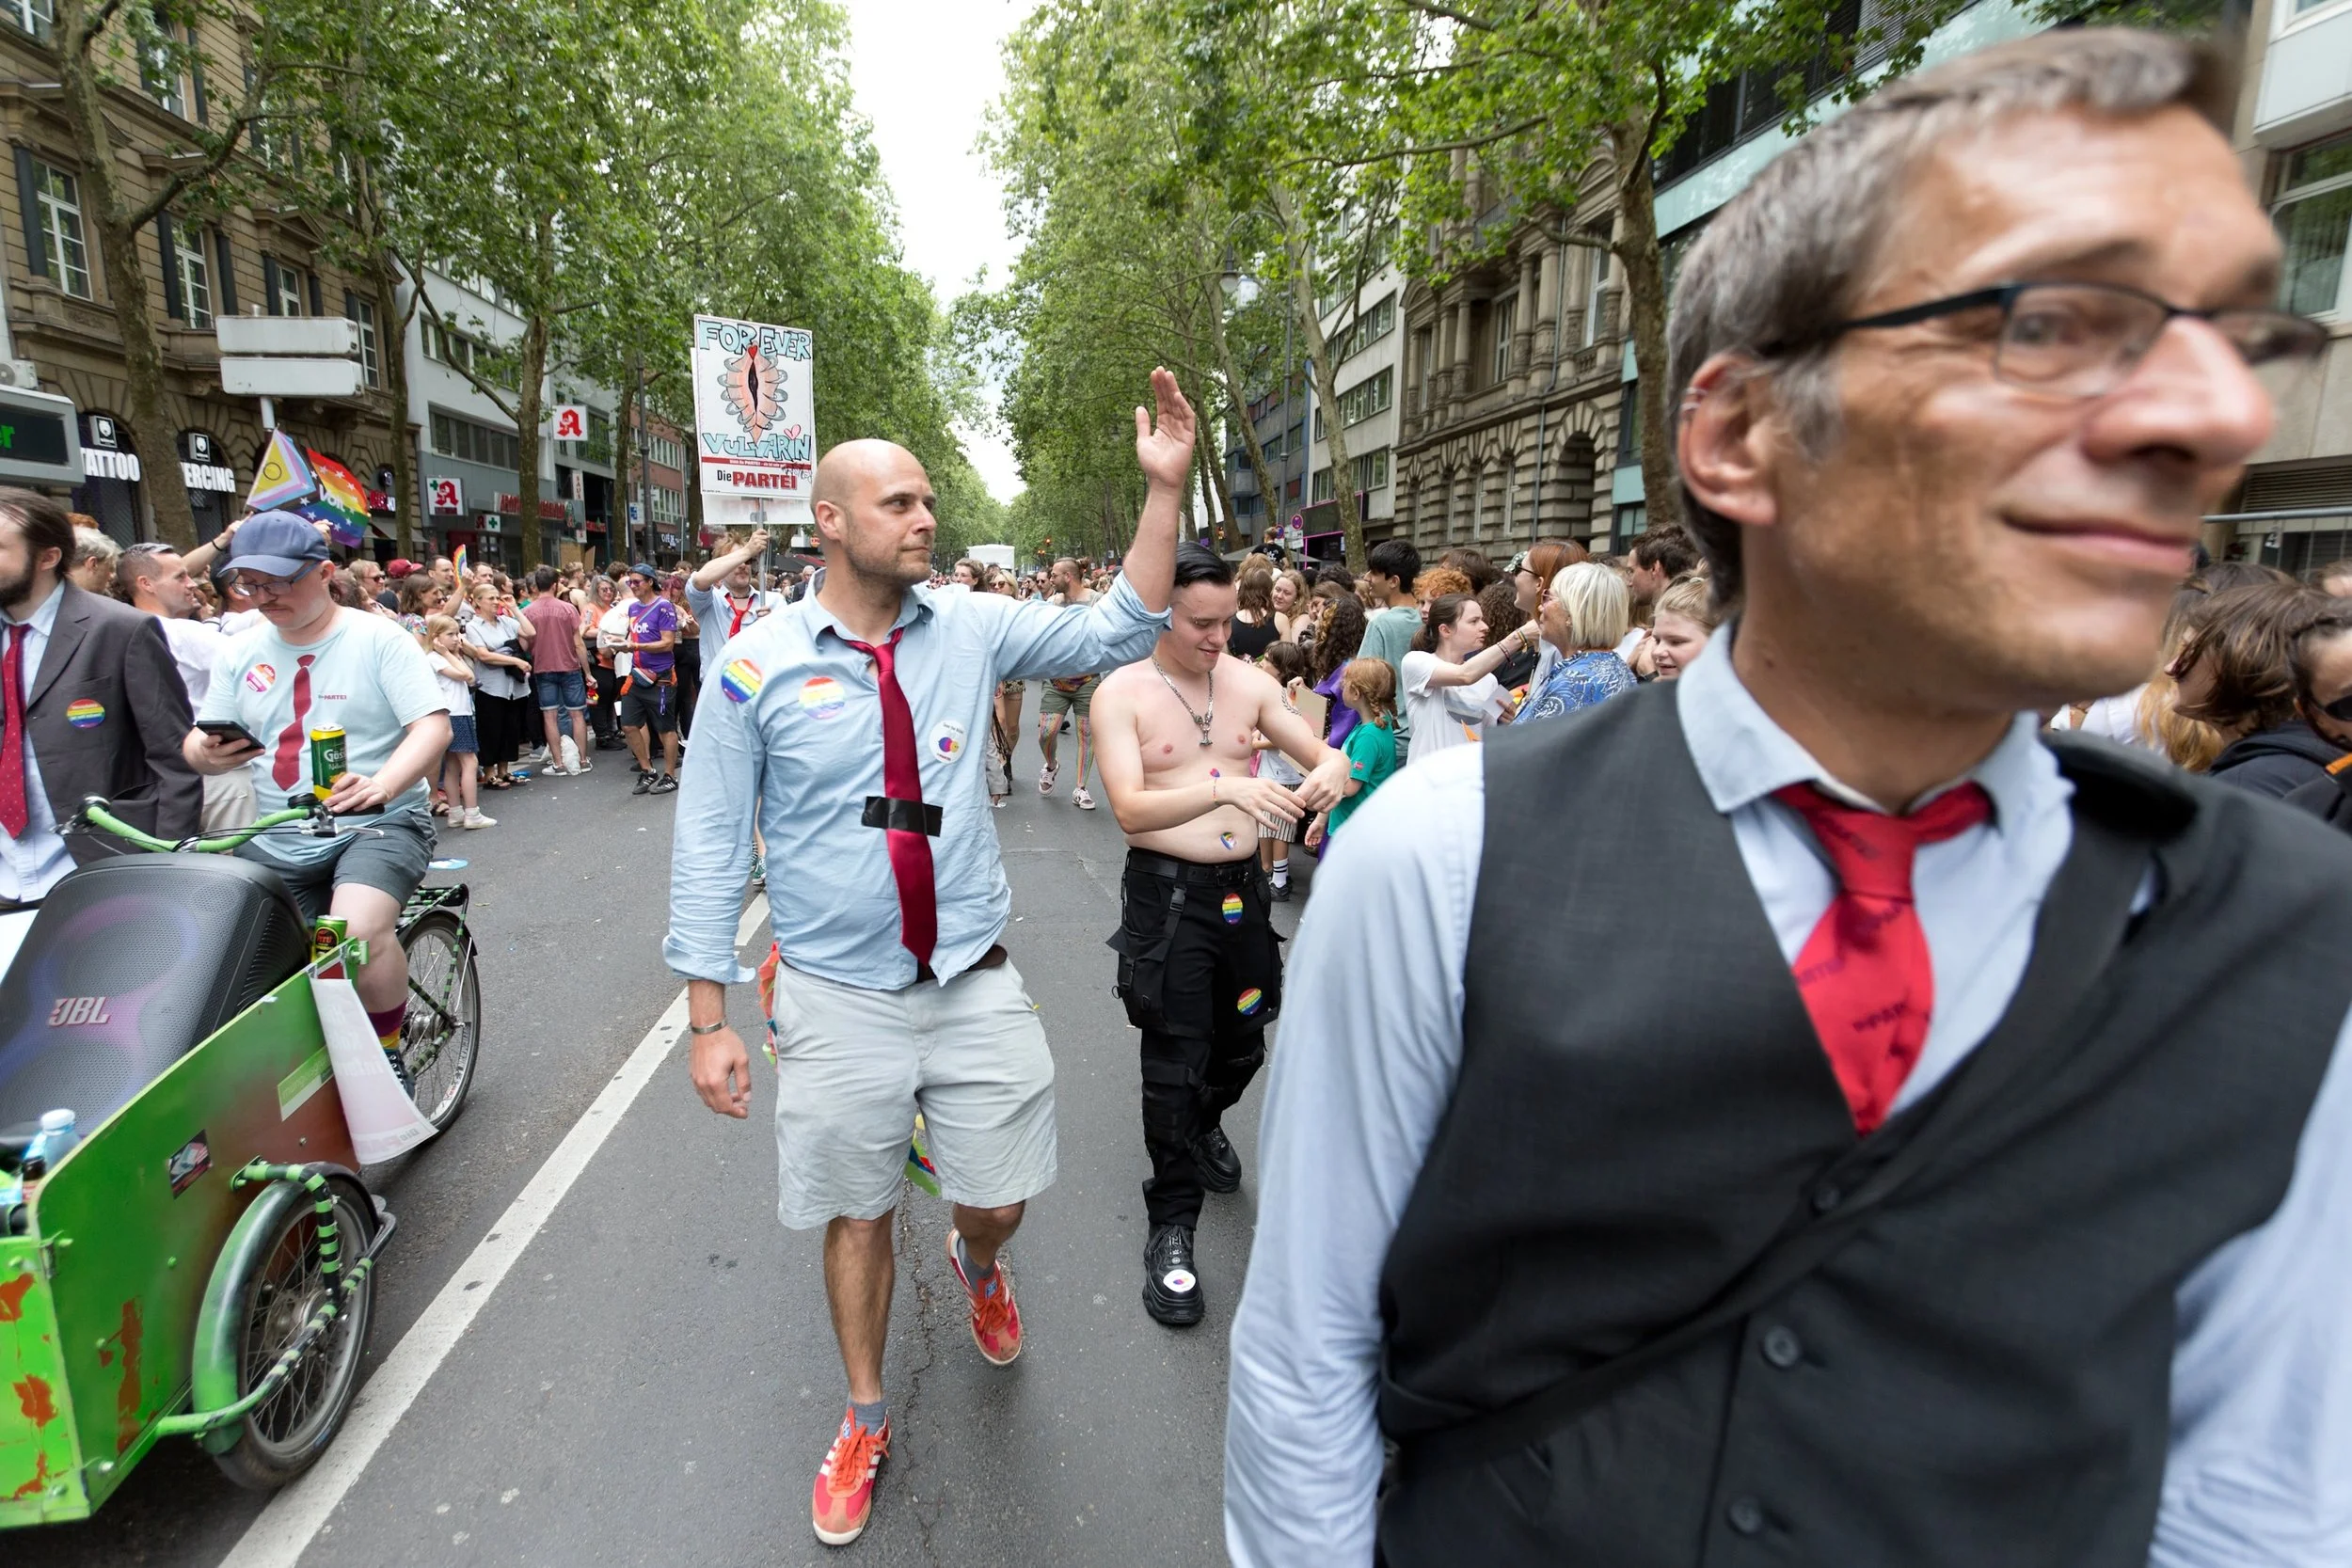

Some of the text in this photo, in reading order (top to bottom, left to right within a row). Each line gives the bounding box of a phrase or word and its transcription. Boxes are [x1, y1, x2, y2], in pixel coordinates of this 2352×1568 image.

[697, 320, 812, 361] FOREVER
[702, 433, 811, 462] VULVARIN
[717, 470, 797, 490] Die PARTEI
[48, 997, 111, 1027] JBL
